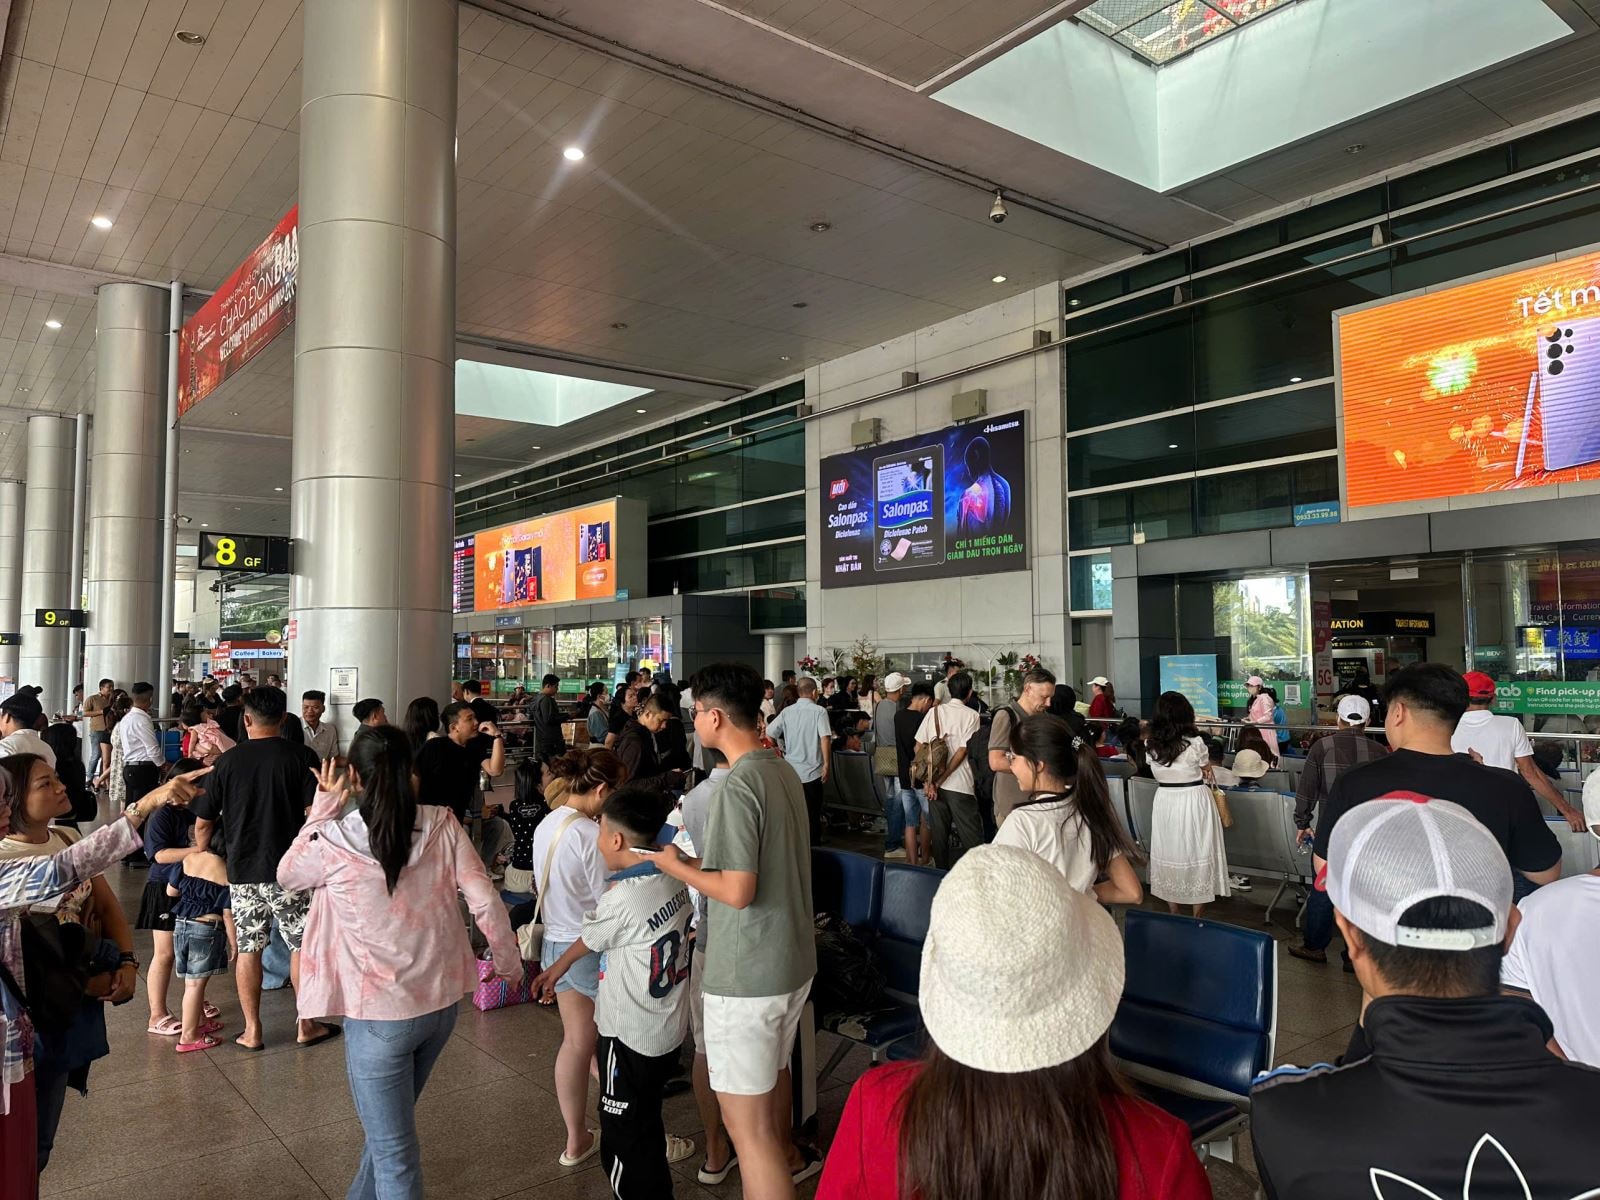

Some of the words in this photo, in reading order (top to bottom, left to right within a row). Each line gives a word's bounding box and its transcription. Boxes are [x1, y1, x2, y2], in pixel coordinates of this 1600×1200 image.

[1516, 286, 1563, 318] Tết
[1570, 285, 1600, 307] m
[882, 500, 929, 519] Salonpas
[828, 511, 868, 528] Salonpas
[912, 524, 928, 534] Patch
[216, 538, 237, 565] 8
[244, 557, 261, 566] GF
[44, 611, 56, 625] 9
[1330, 619, 1364, 629] MATION
[1573, 613, 1600, 621] Curren
[1318, 669, 1332, 686] 5G
[1494, 684, 1522, 697] rab
[1536, 687, 1556, 695] Find
[1558, 687, 1595, 697] pick-up
[601, 1095, 629, 1109] CLEVER
[603, 1104, 624, 1115] KIDS
